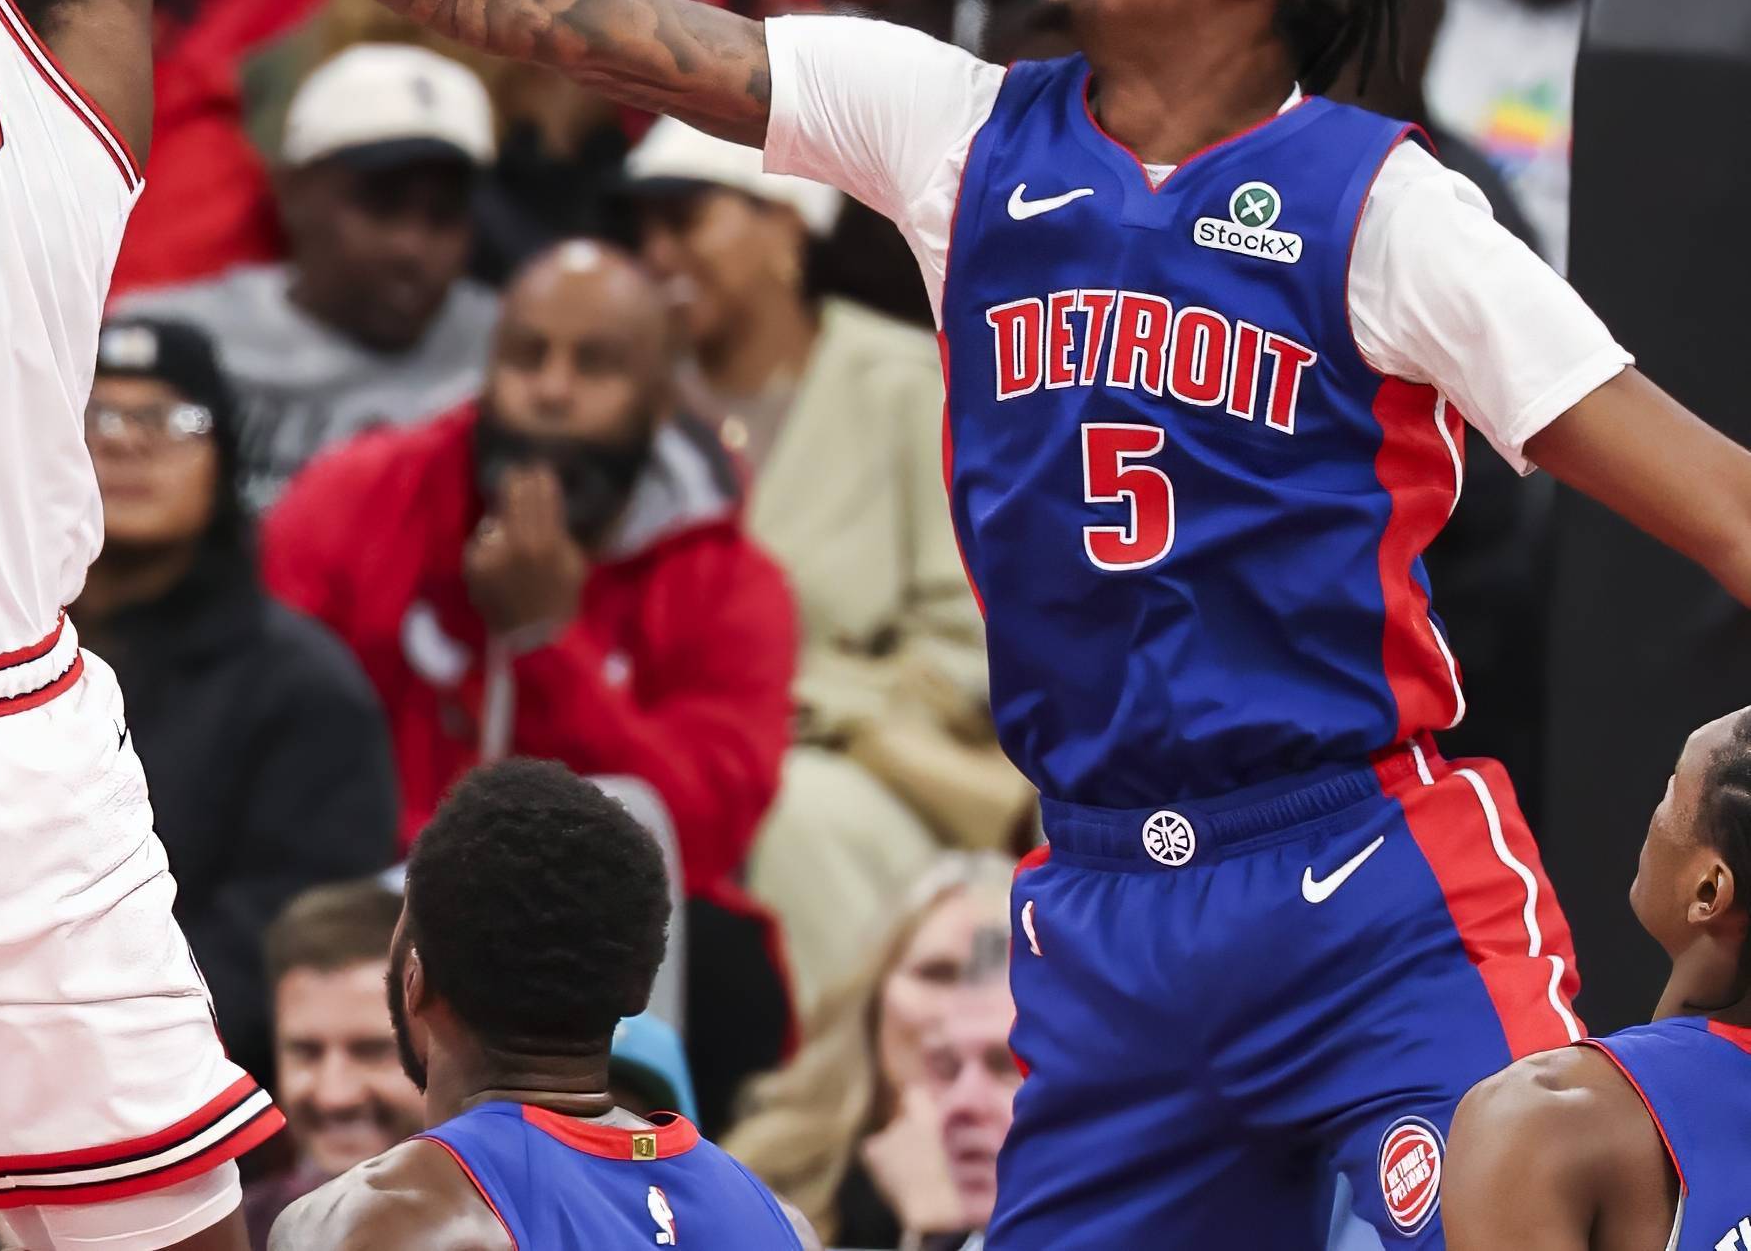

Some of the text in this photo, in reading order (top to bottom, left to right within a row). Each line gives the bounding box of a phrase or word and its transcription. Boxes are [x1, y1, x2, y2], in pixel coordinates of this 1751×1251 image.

[1199, 222, 1297, 258] StockX
[986, 288, 1318, 435] DETROIT
[1081, 422, 1176, 572] 5
